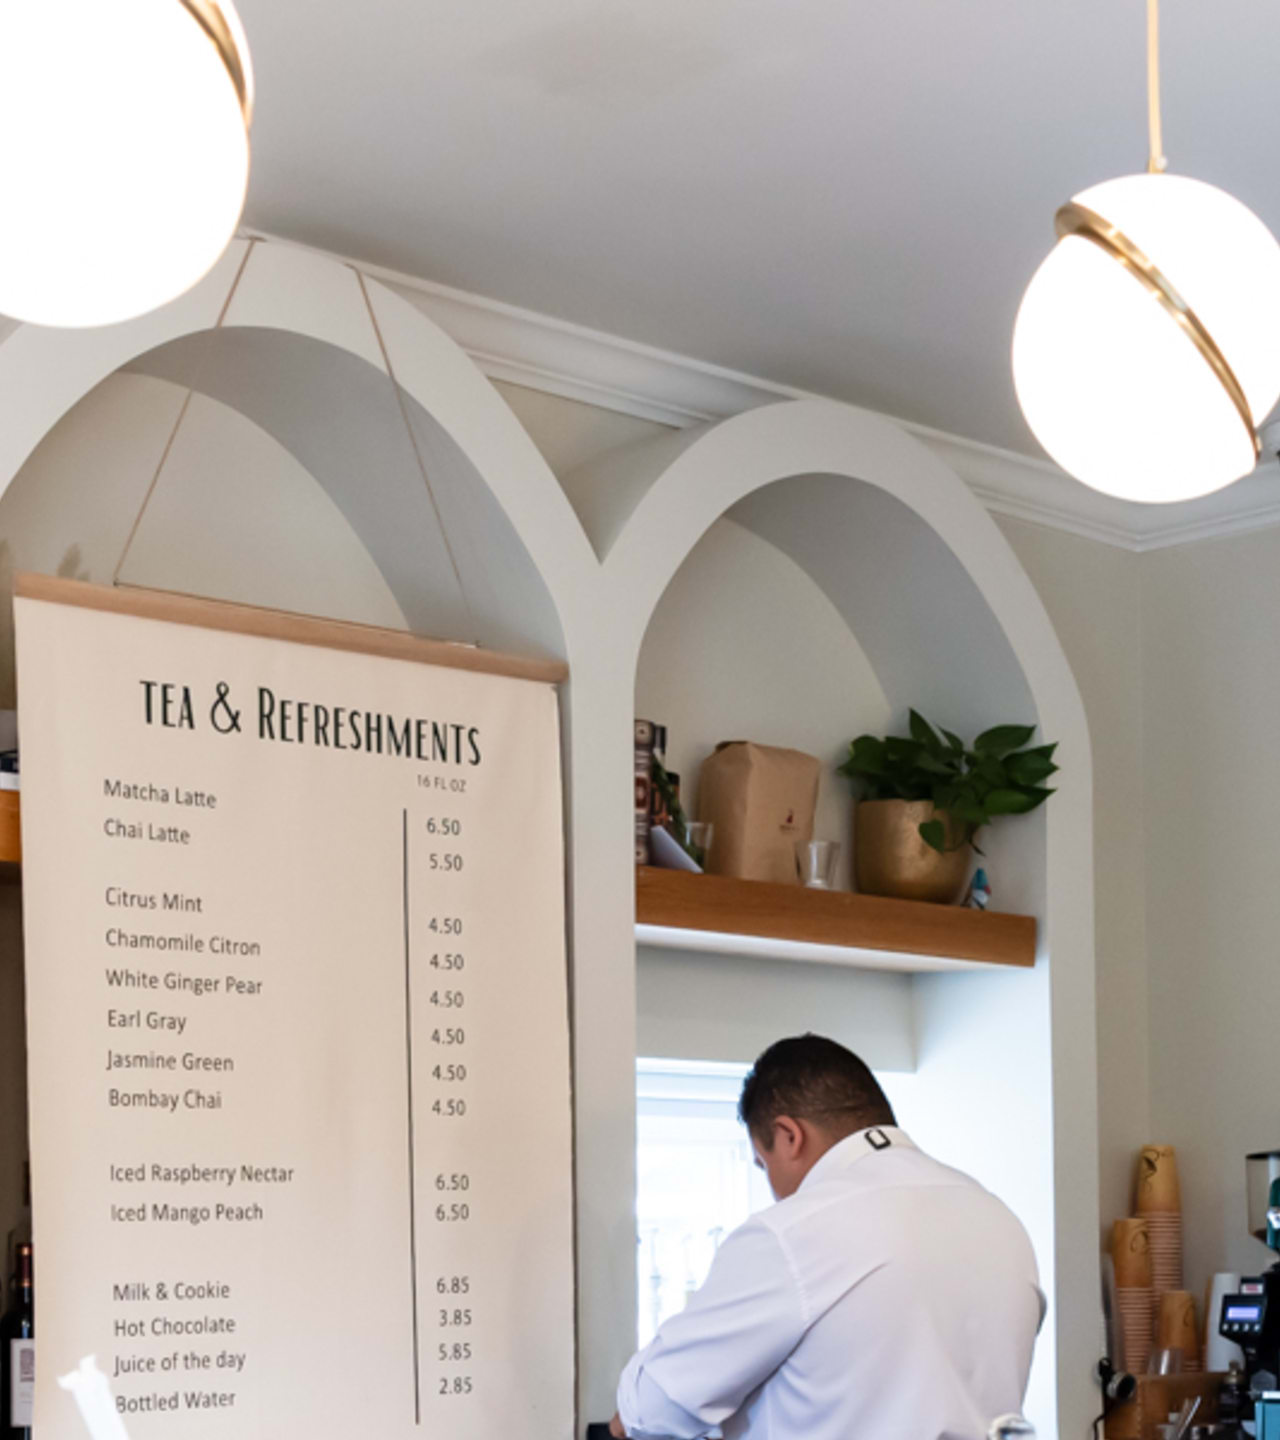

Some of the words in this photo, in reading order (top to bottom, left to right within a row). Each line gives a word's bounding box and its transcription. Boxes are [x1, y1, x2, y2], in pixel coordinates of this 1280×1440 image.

[139, 679, 195, 730] TEA
[209, 680, 242, 734] &
[257, 686, 482, 766] REFRESHMENTS
[103, 778, 170, 805] Matcha
[174, 786, 218, 810] Latte
[416, 773, 432, 789] 16
[433, 775, 448, 791] FL
[448, 778, 467, 794] OZ
[103, 817, 144, 840] Chai
[147, 822, 192, 846] Latte
[425, 816, 462, 837] 6.50
[428, 852, 464, 873] 5.50
[104, 886, 158, 911] Citrus
[161, 891, 203, 914] Mint
[427, 916, 463, 937] 4.50
[104, 927, 206, 954] Chamomile
[208, 935, 261, 957] Citron
[428, 952, 465, 972] 4.50
[104, 967, 161, 990] White
[162, 970, 221, 997] Ginger
[225, 975, 264, 996] Pear
[429, 989, 465, 1009] 4.50
[107, 1008, 142, 1029] Earl
[145, 1010, 188, 1036] Gray
[430, 1027, 466, 1046] 4.50
[104, 1048, 178, 1072] Jasmine
[180, 1051, 235, 1073] Green
[431, 1063, 468, 1083] 4.50
[107, 1087, 180, 1114] Bombay
[182, 1088, 223, 1110] Chai
[431, 1097, 467, 1117] 4.50
[109, 1162, 147, 1184] Iced
[150, 1162, 237, 1188] Raspberry
[239, 1164, 295, 1184] Nectar
[434, 1172, 470, 1192] 6.50
[110, 1202, 148, 1223] Iced
[151, 1202, 211, 1227] Mango
[214, 1202, 264, 1222] Peach
[434, 1203, 470, 1222] 6.50
[112, 1282, 151, 1302] Milk
[155, 1280, 170, 1302] &
[172, 1280, 231, 1301] Cookie
[436, 1275, 470, 1295] 6.85
[113, 1318, 146, 1338] Hot
[150, 1315, 237, 1337] Chocolate
[438, 1308, 473, 1328] 3.85
[438, 1342, 472, 1362] 5.85
[112, 1354, 157, 1379] Juice
[160, 1350, 180, 1372] of
[182, 1350, 212, 1371] the
[215, 1349, 247, 1373] day
[438, 1375, 473, 1396] 2.85
[114, 1390, 180, 1415] Bottled
[182, 1390, 237, 1410] Water
